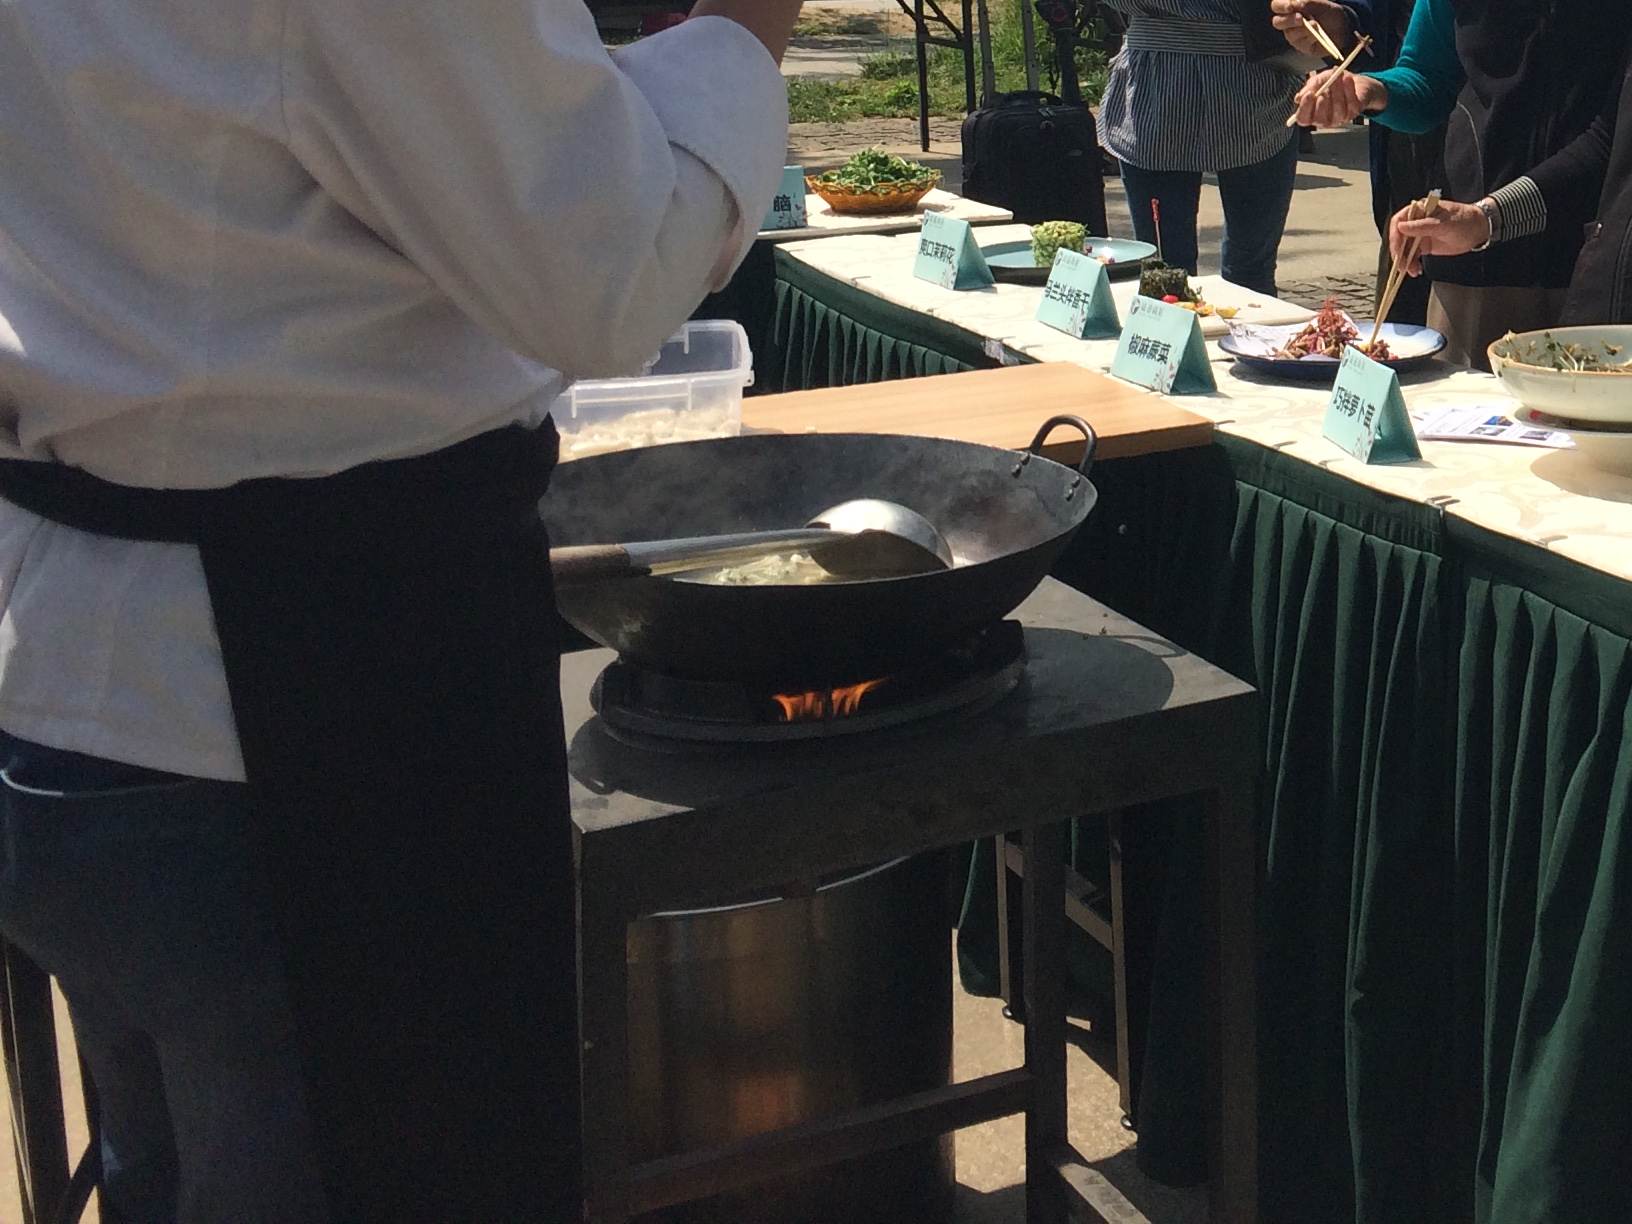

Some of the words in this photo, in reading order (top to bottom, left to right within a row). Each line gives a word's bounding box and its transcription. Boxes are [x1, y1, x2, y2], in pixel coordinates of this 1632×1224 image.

[918, 237, 956, 265] 爽口茉莉花
[1044, 279, 1091, 311] 马兰头拌香干
[1127, 332, 1172, 365] 椒麻蕨菜
